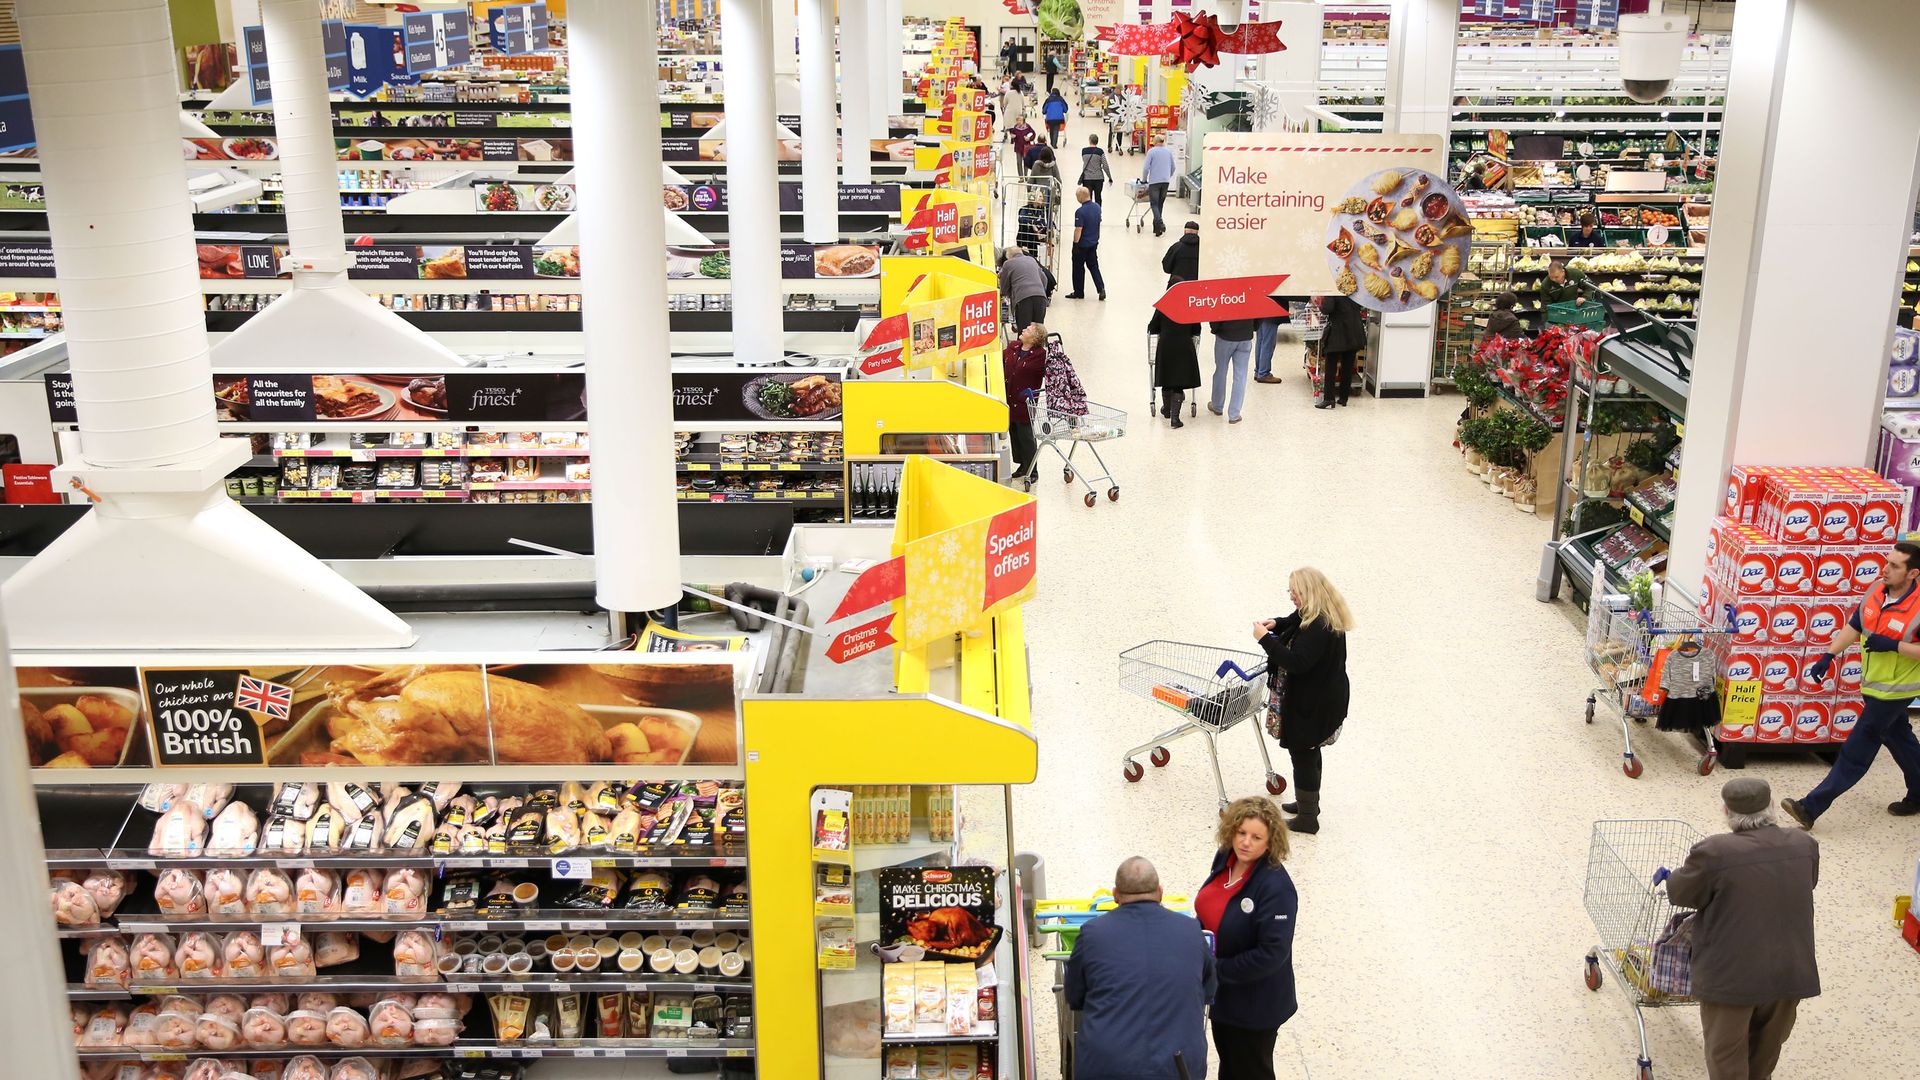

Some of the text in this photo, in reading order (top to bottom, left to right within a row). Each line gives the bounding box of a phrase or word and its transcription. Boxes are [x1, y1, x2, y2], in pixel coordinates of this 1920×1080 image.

[353, 76, 368, 84] Milk
[975, 95, 984, 107] £2
[976, 159, 989, 168] FREE
[1218, 165, 1268, 185] Make
[1216, 190, 1325, 212] entertaining
[937, 208, 956, 222] Half
[1216, 213, 1268, 230] easier
[935, 224, 956, 238] price
[496, 250, 508, 258] only
[247, 254, 270, 268] LOVE
[1188, 292, 1246, 310] Party food
[965, 300, 993, 320] Half
[962, 321, 995, 342] price
[868, 357, 892, 369] Party food
[253, 380, 278, 388] All the
[254, 390, 306, 398] favourites for
[281, 399, 306, 408] family
[469, 390, 517, 411] finest
[1786, 514, 1809, 526] Daz
[1824, 514, 1847, 526] Daz
[1864, 514, 1887, 526] Daz
[990, 520, 1034, 556] Special
[994, 550, 1030, 578] offers
[1742, 567, 1764, 578] Daz
[1779, 566, 1802, 578] Daz
[1818, 567, 1841, 578] Daz
[1856, 566, 1879, 577] Daz
[1736, 618, 1758, 628] Daz
[1773, 617, 1796, 628] Daz
[1811, 617, 1836, 628] Daz
[843, 626, 878, 645] Christmas
[843, 639, 876, 659] puddings
[1728, 666, 1751, 677] Daz
[1765, 666, 1788, 677] Daz
[155, 678, 215, 696] Our whole
[1736, 685, 1756, 693] Half
[159, 692, 234, 708] chickens are
[160, 708, 242, 733] 100%
[1760, 714, 1782, 725] Daz
[1797, 714, 1819, 725] Daz
[1833, 714, 1856, 725] Daz
[163, 731, 253, 755] British
[892, 882, 982, 894] MAKE CHRISTMAS
[892, 893, 982, 908] DELICIOUS
